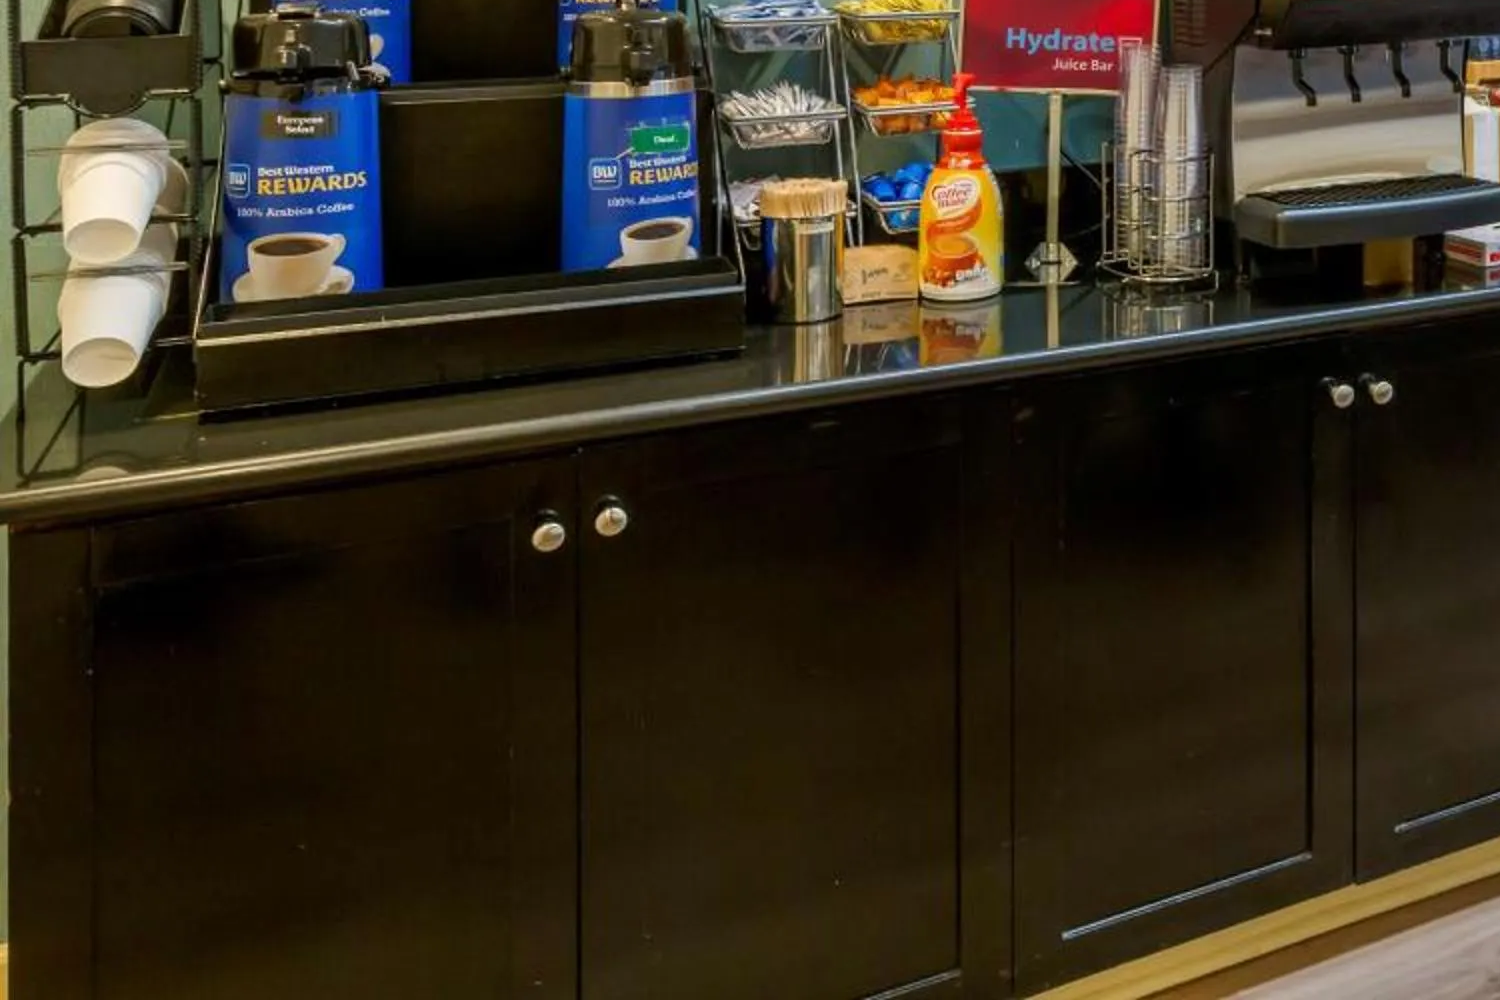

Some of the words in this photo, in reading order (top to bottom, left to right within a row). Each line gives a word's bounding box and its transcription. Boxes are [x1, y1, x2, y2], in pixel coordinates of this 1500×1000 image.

[1006, 27, 1116, 55] Hydrate
[1052, 58, 1088, 71] Juice
[1091, 59, 1114, 71] Bar
[257, 166, 283, 177] Best
[284, 164, 334, 176] Western
[629, 161, 698, 185] REWAR
[257, 171, 367, 196] REWARDS
[237, 207, 263, 217] 100%
[265, 203, 315, 217] Arabica
[316, 202, 355, 215] Coffee
